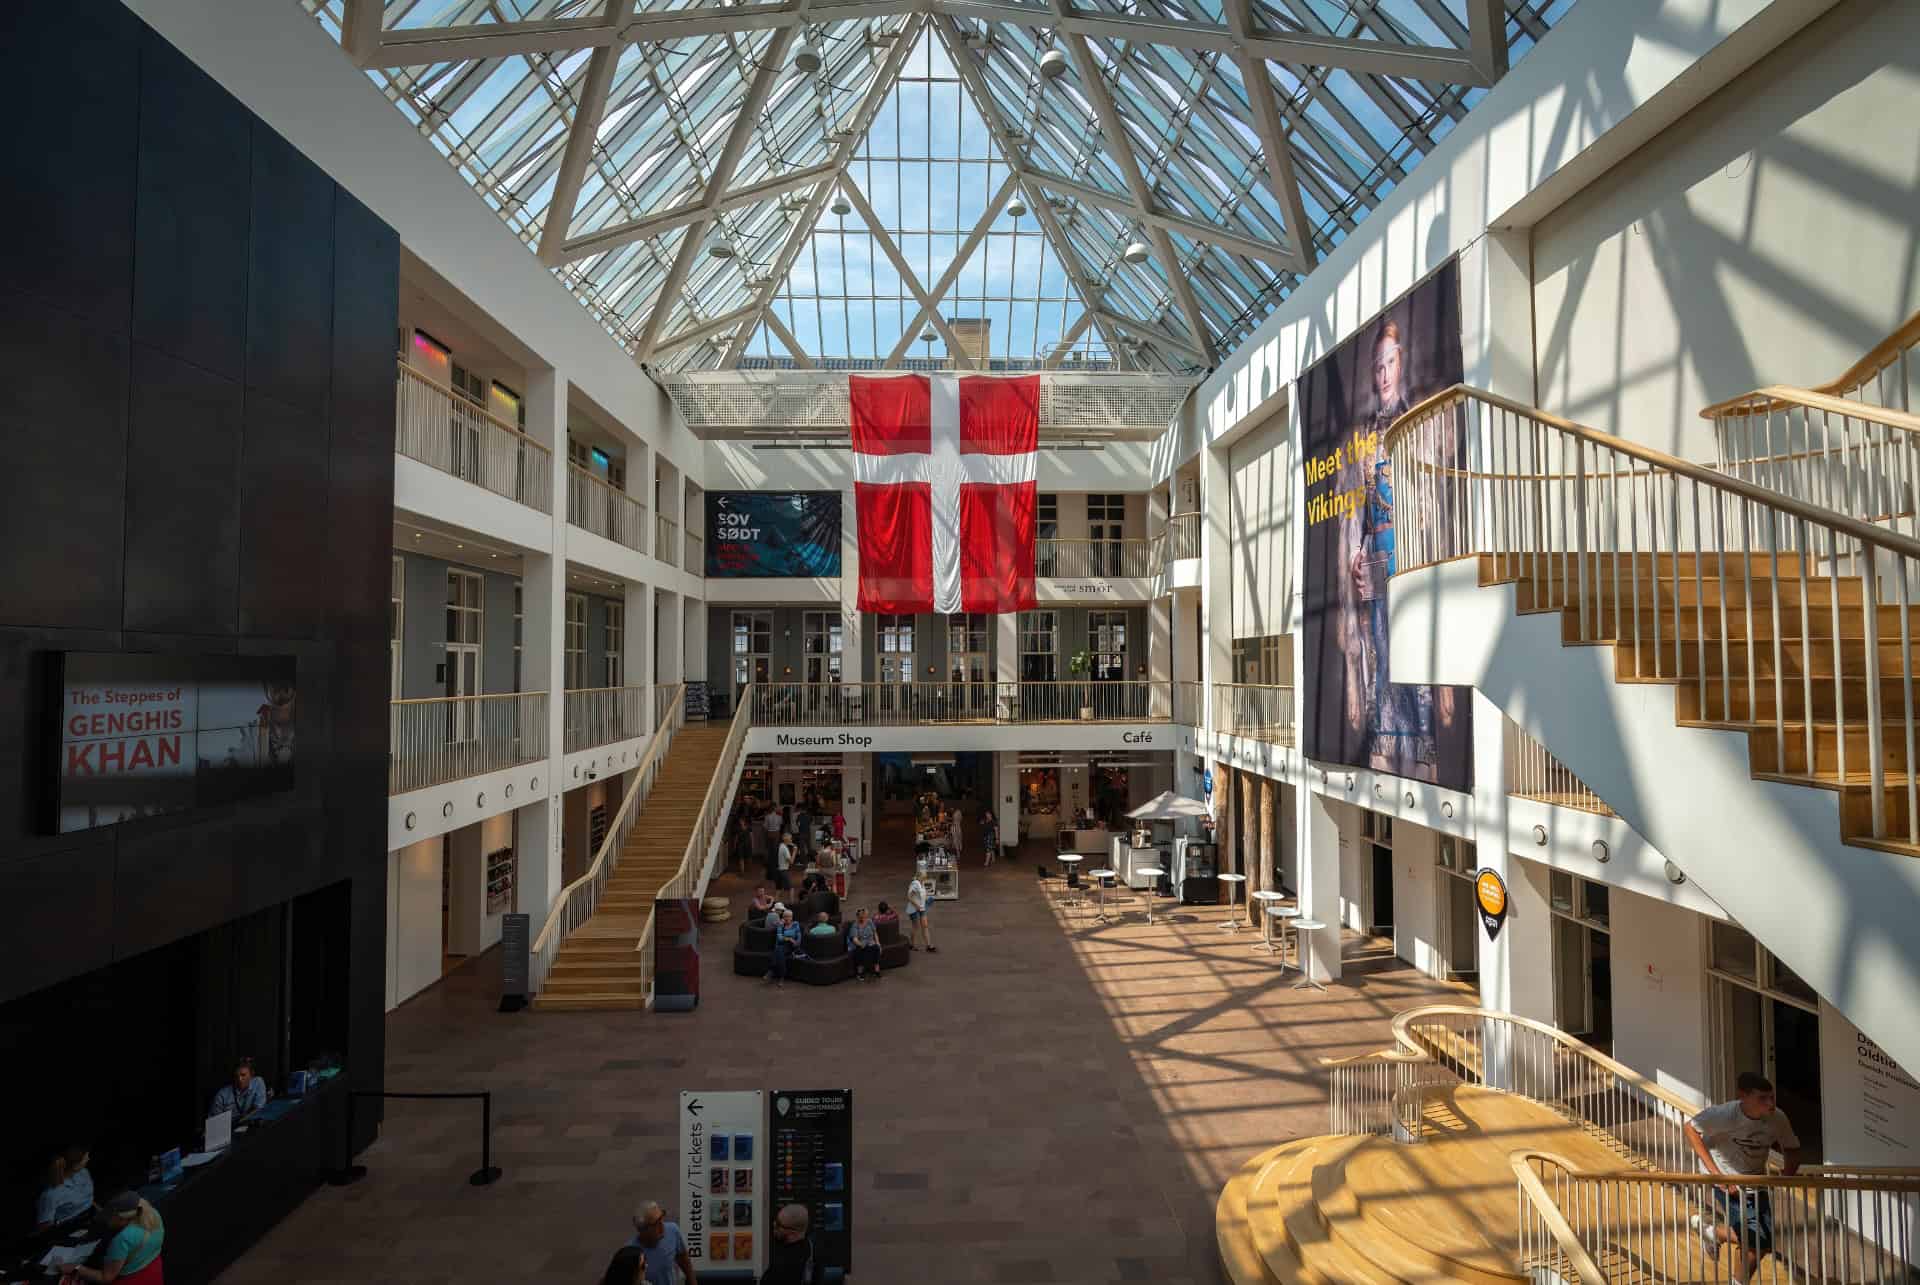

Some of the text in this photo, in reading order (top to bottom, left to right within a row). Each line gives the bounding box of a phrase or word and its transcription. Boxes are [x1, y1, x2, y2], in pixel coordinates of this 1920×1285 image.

[1305, 430, 1377, 487] Meet the
[717, 513, 750, 526] SOV
[1307, 485, 1366, 527] Vikings
[717, 528, 761, 540] SØDT
[72, 688, 182, 706] The Steppes of
[68, 709, 183, 737] GENGHIS
[1123, 731, 1152, 743] Café
[777, 733, 872, 747] Museum Shop
[67, 735, 182, 777] KHAN
[687, 1122, 703, 1178] Tickets
[687, 1191, 702, 1258] Billetter
